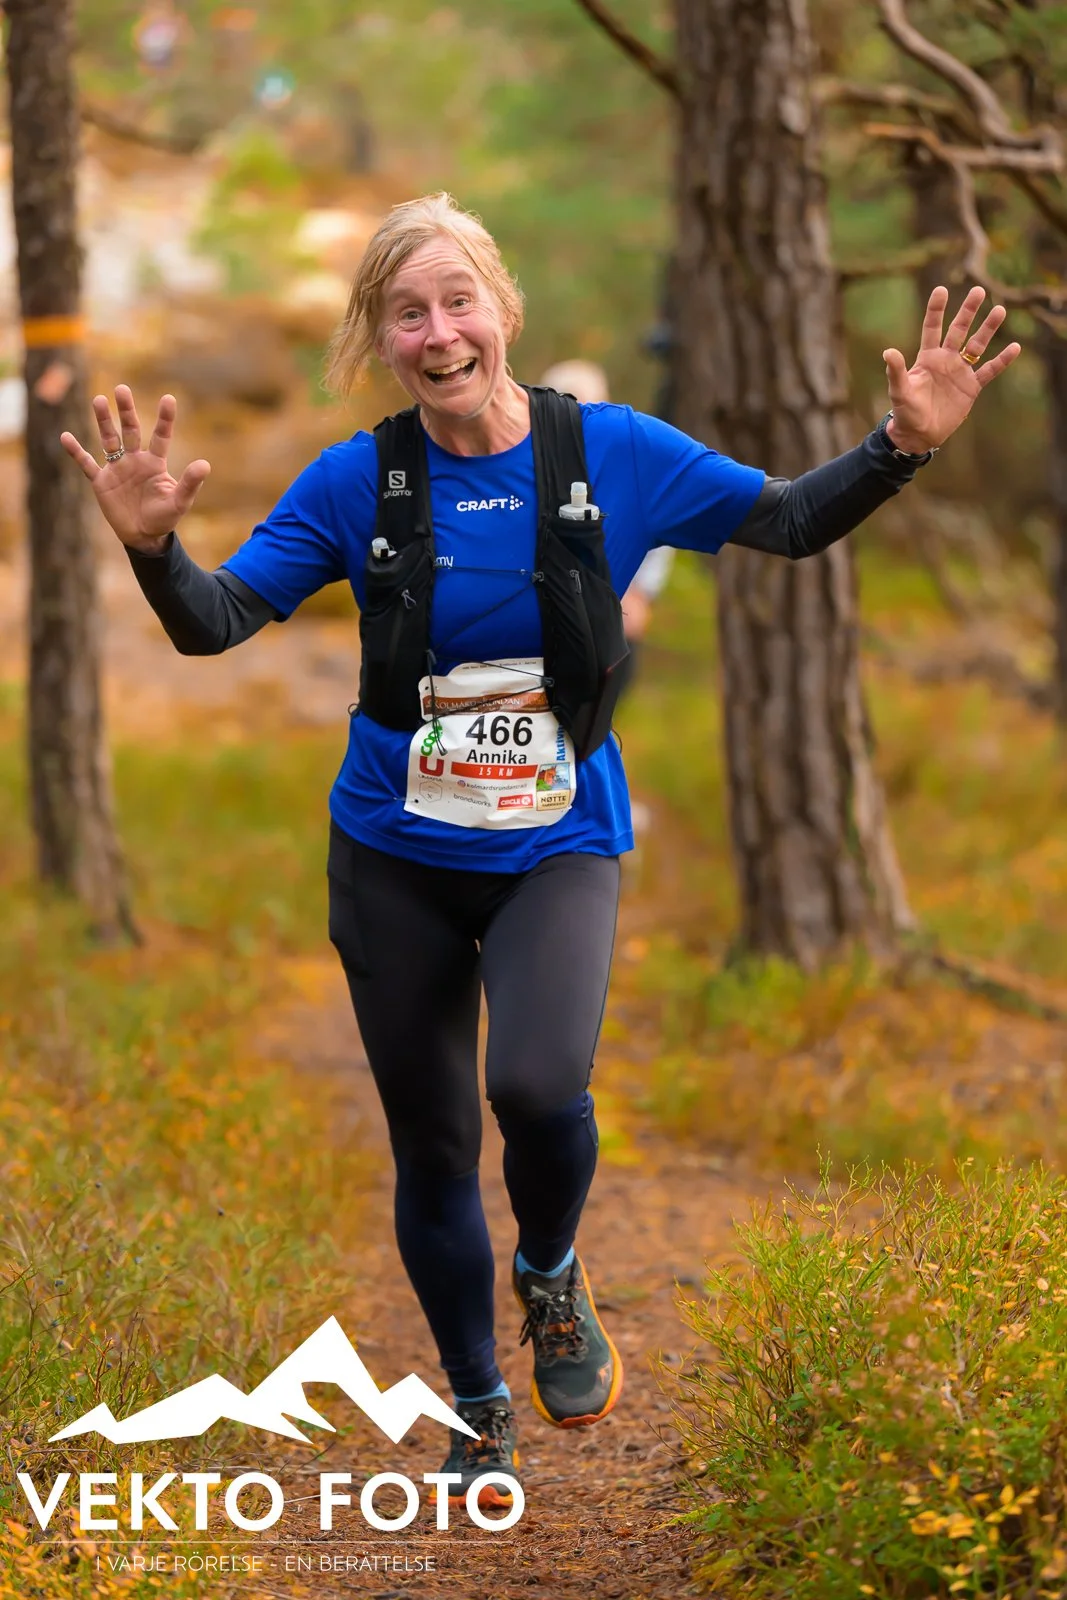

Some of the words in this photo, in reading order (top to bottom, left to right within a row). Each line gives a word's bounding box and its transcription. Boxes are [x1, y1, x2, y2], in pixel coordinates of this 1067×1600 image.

[456, 498, 508, 512] CRAFT
[465, 715, 533, 746] 466
[466, 749, 527, 764] Annika
[478, 767, 492, 776] 15
[498, 768, 514, 777] KM
